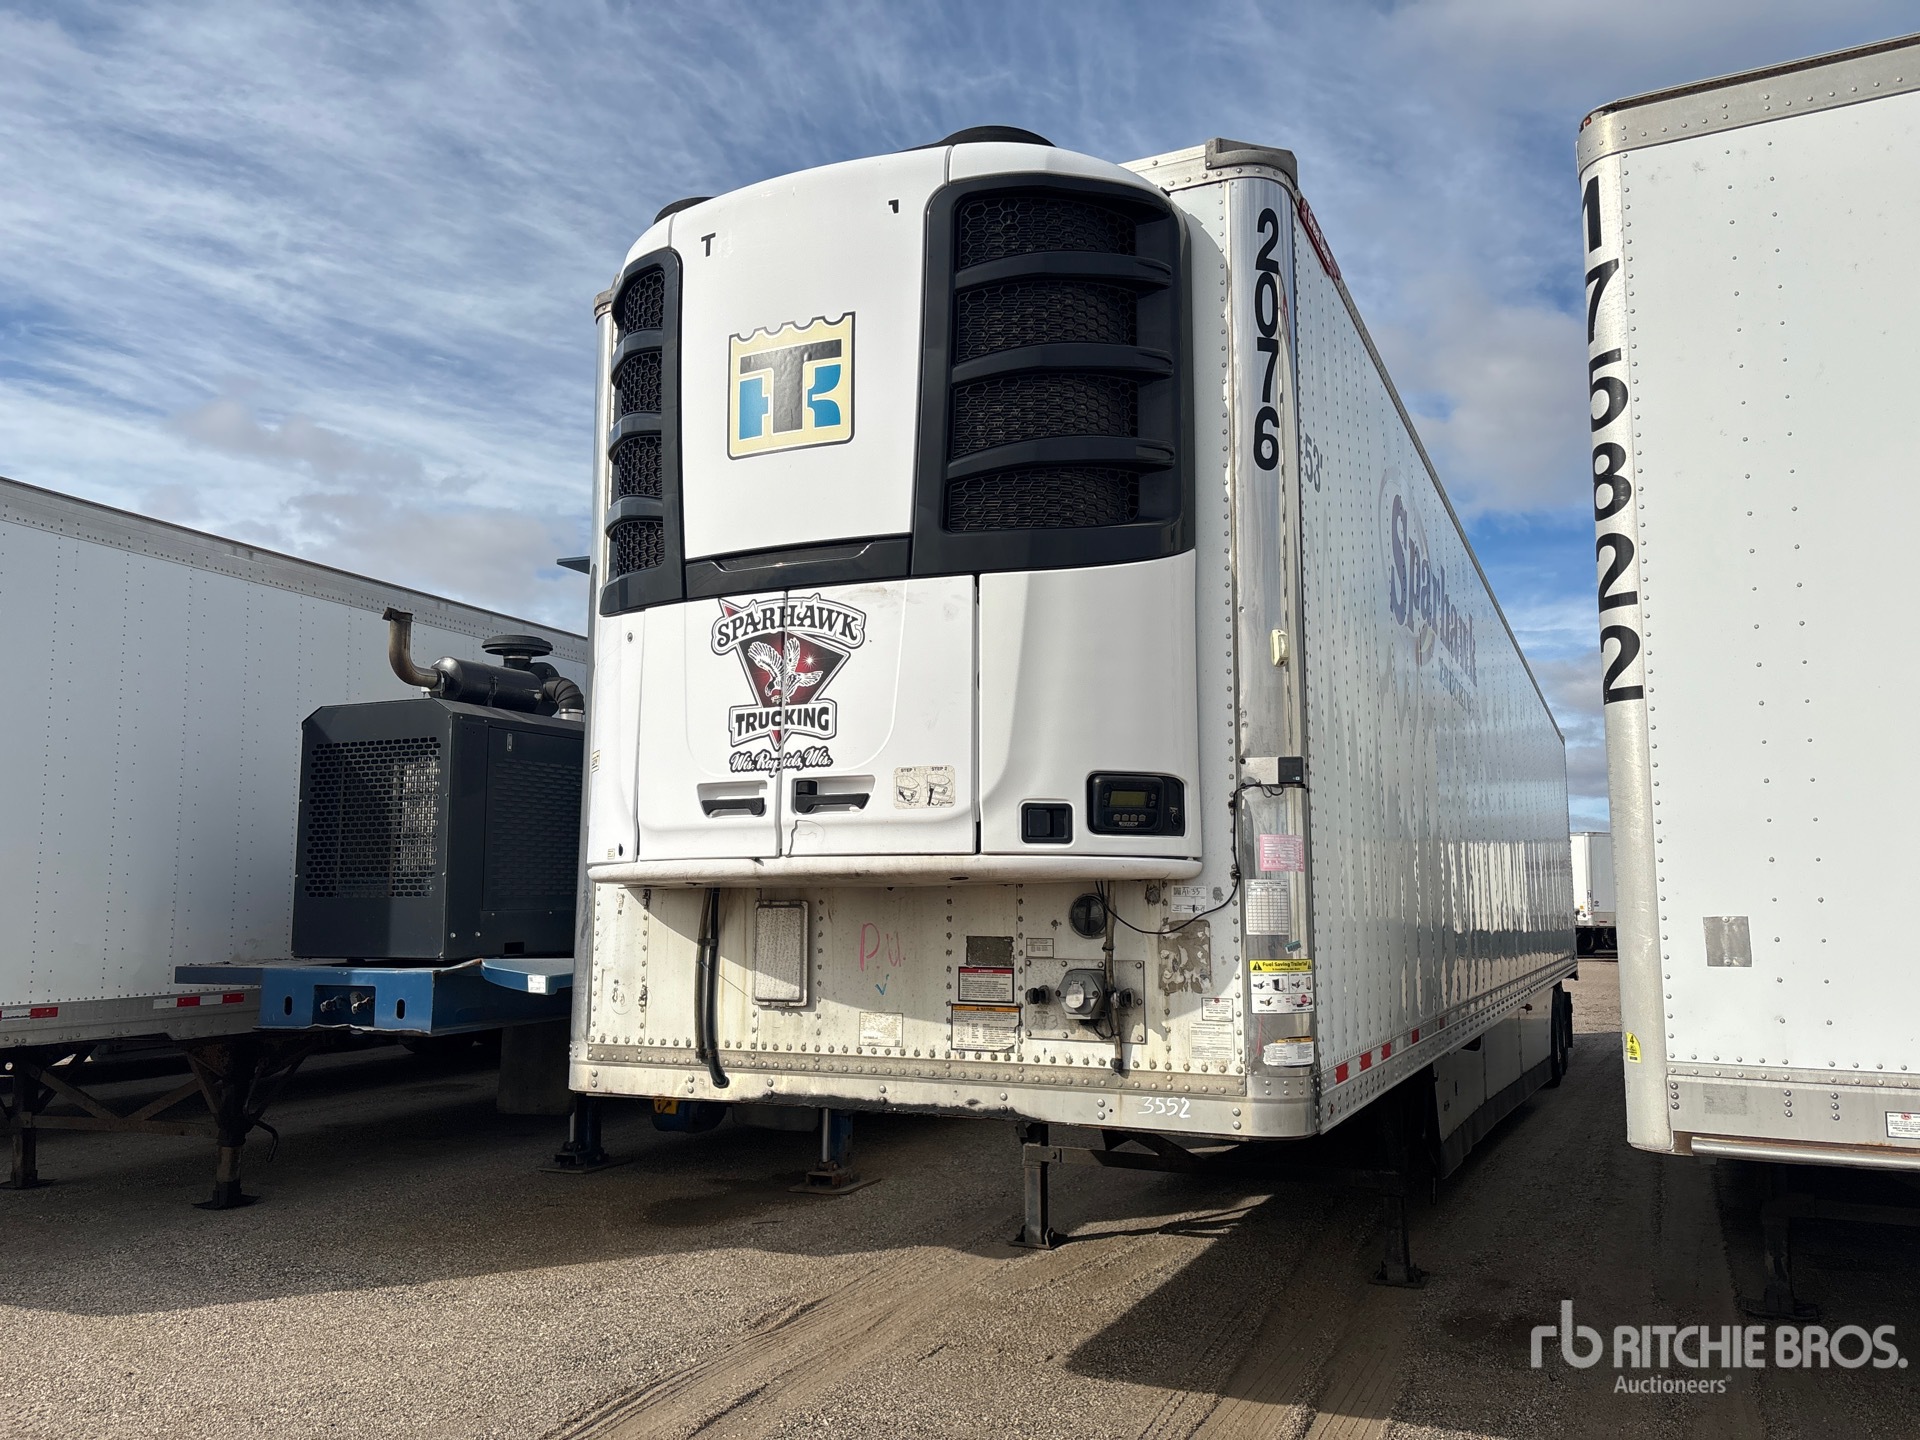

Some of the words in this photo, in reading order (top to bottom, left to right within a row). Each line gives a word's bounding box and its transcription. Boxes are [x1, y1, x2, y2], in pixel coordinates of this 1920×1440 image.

[1253, 207, 1279, 471] 2076
[1582, 175, 1644, 705] 175822
[717, 603, 858, 648] SPARHAWK
[735, 706, 829, 737] TRUCKING
[729, 751, 755, 773] Wis.
[803, 746, 833, 769] Wis.
[1138, 1096, 1191, 1118] 3552
